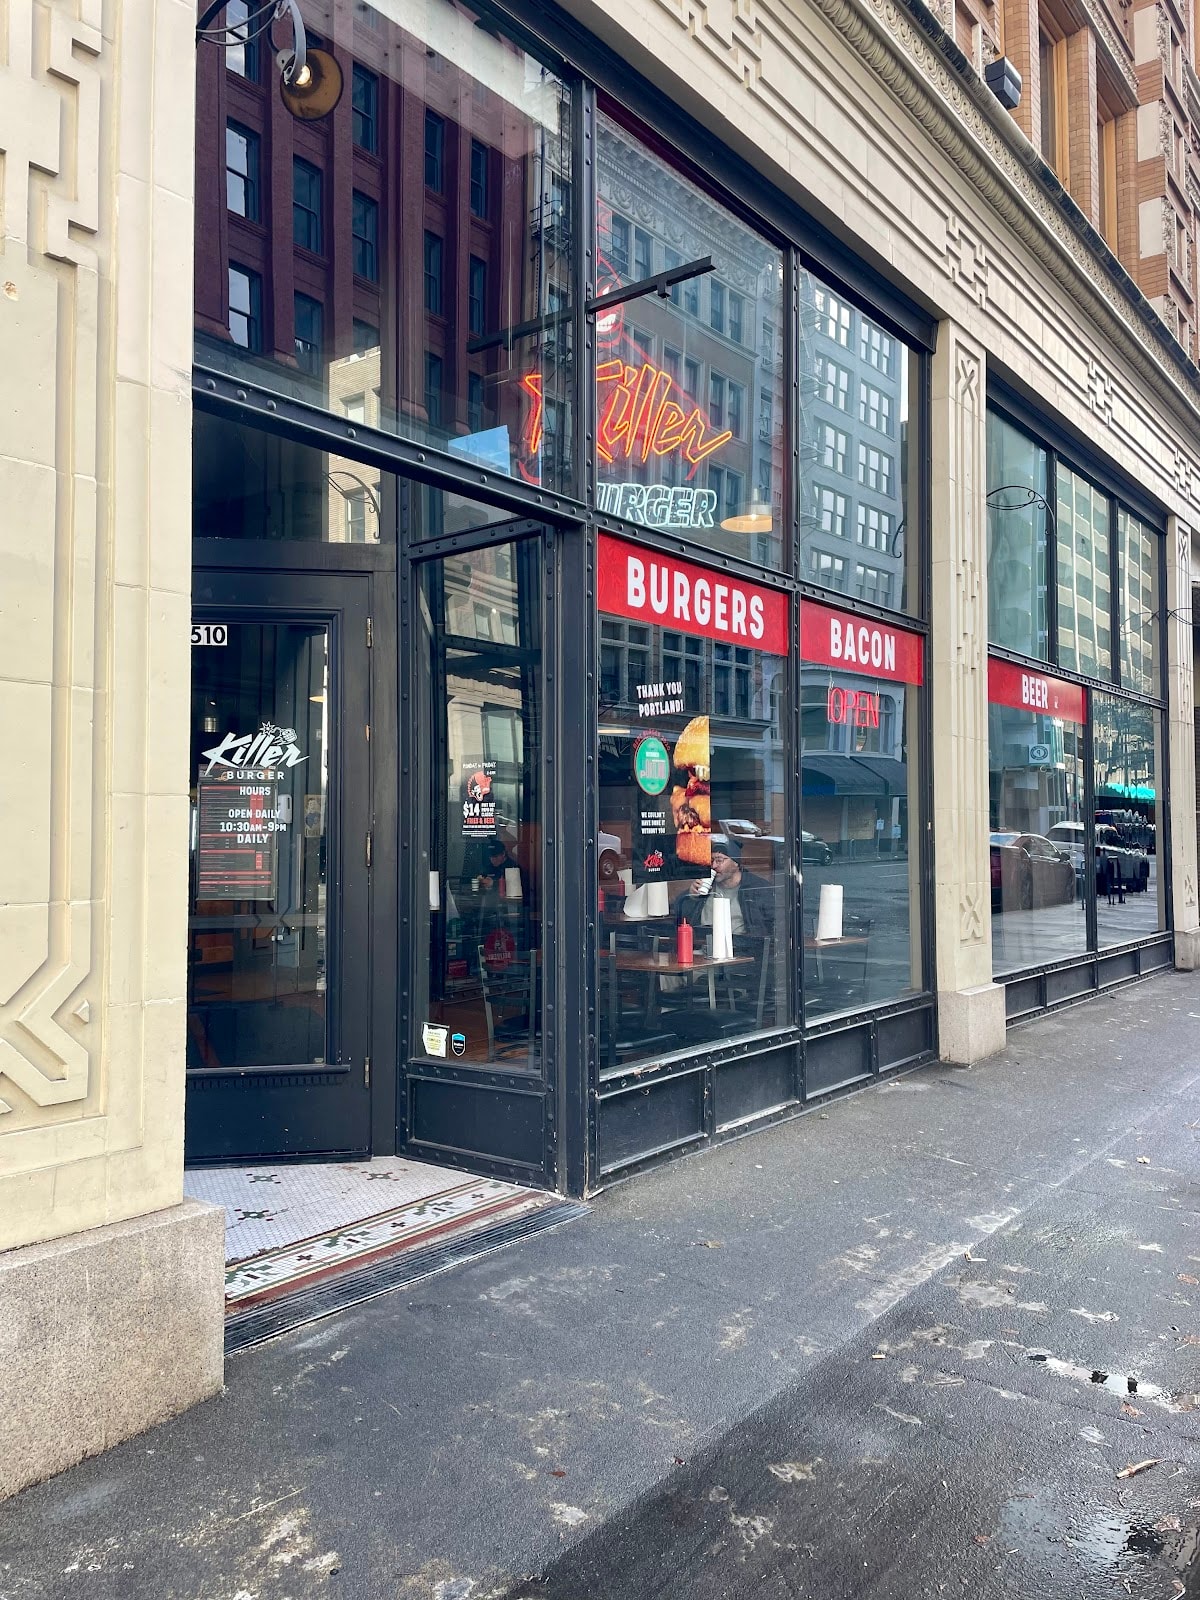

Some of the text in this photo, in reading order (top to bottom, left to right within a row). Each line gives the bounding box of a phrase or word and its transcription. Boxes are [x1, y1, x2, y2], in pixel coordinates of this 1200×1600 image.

[597, 482, 717, 528] URGER
[627, 555, 765, 640] BURGERS
[191, 626, 226, 644] 510
[830, 617, 896, 672] BACON
[636, 681, 682, 699] THANK YOU
[1022, 673, 1049, 710] BEER
[638, 699, 684, 718] PORTLAND!
[830, 687, 879, 728] OPEN
[201, 731, 310, 776] Killer
[227, 770, 285, 781] BURGER
[239, 786, 271, 796] HOURS
[228, 809, 281, 819] OPEN DAILY
[463, 801, 480, 819] $14
[220, 821, 287, 832] 10:30AM-9PM
[237, 833, 269, 844] DAILY
